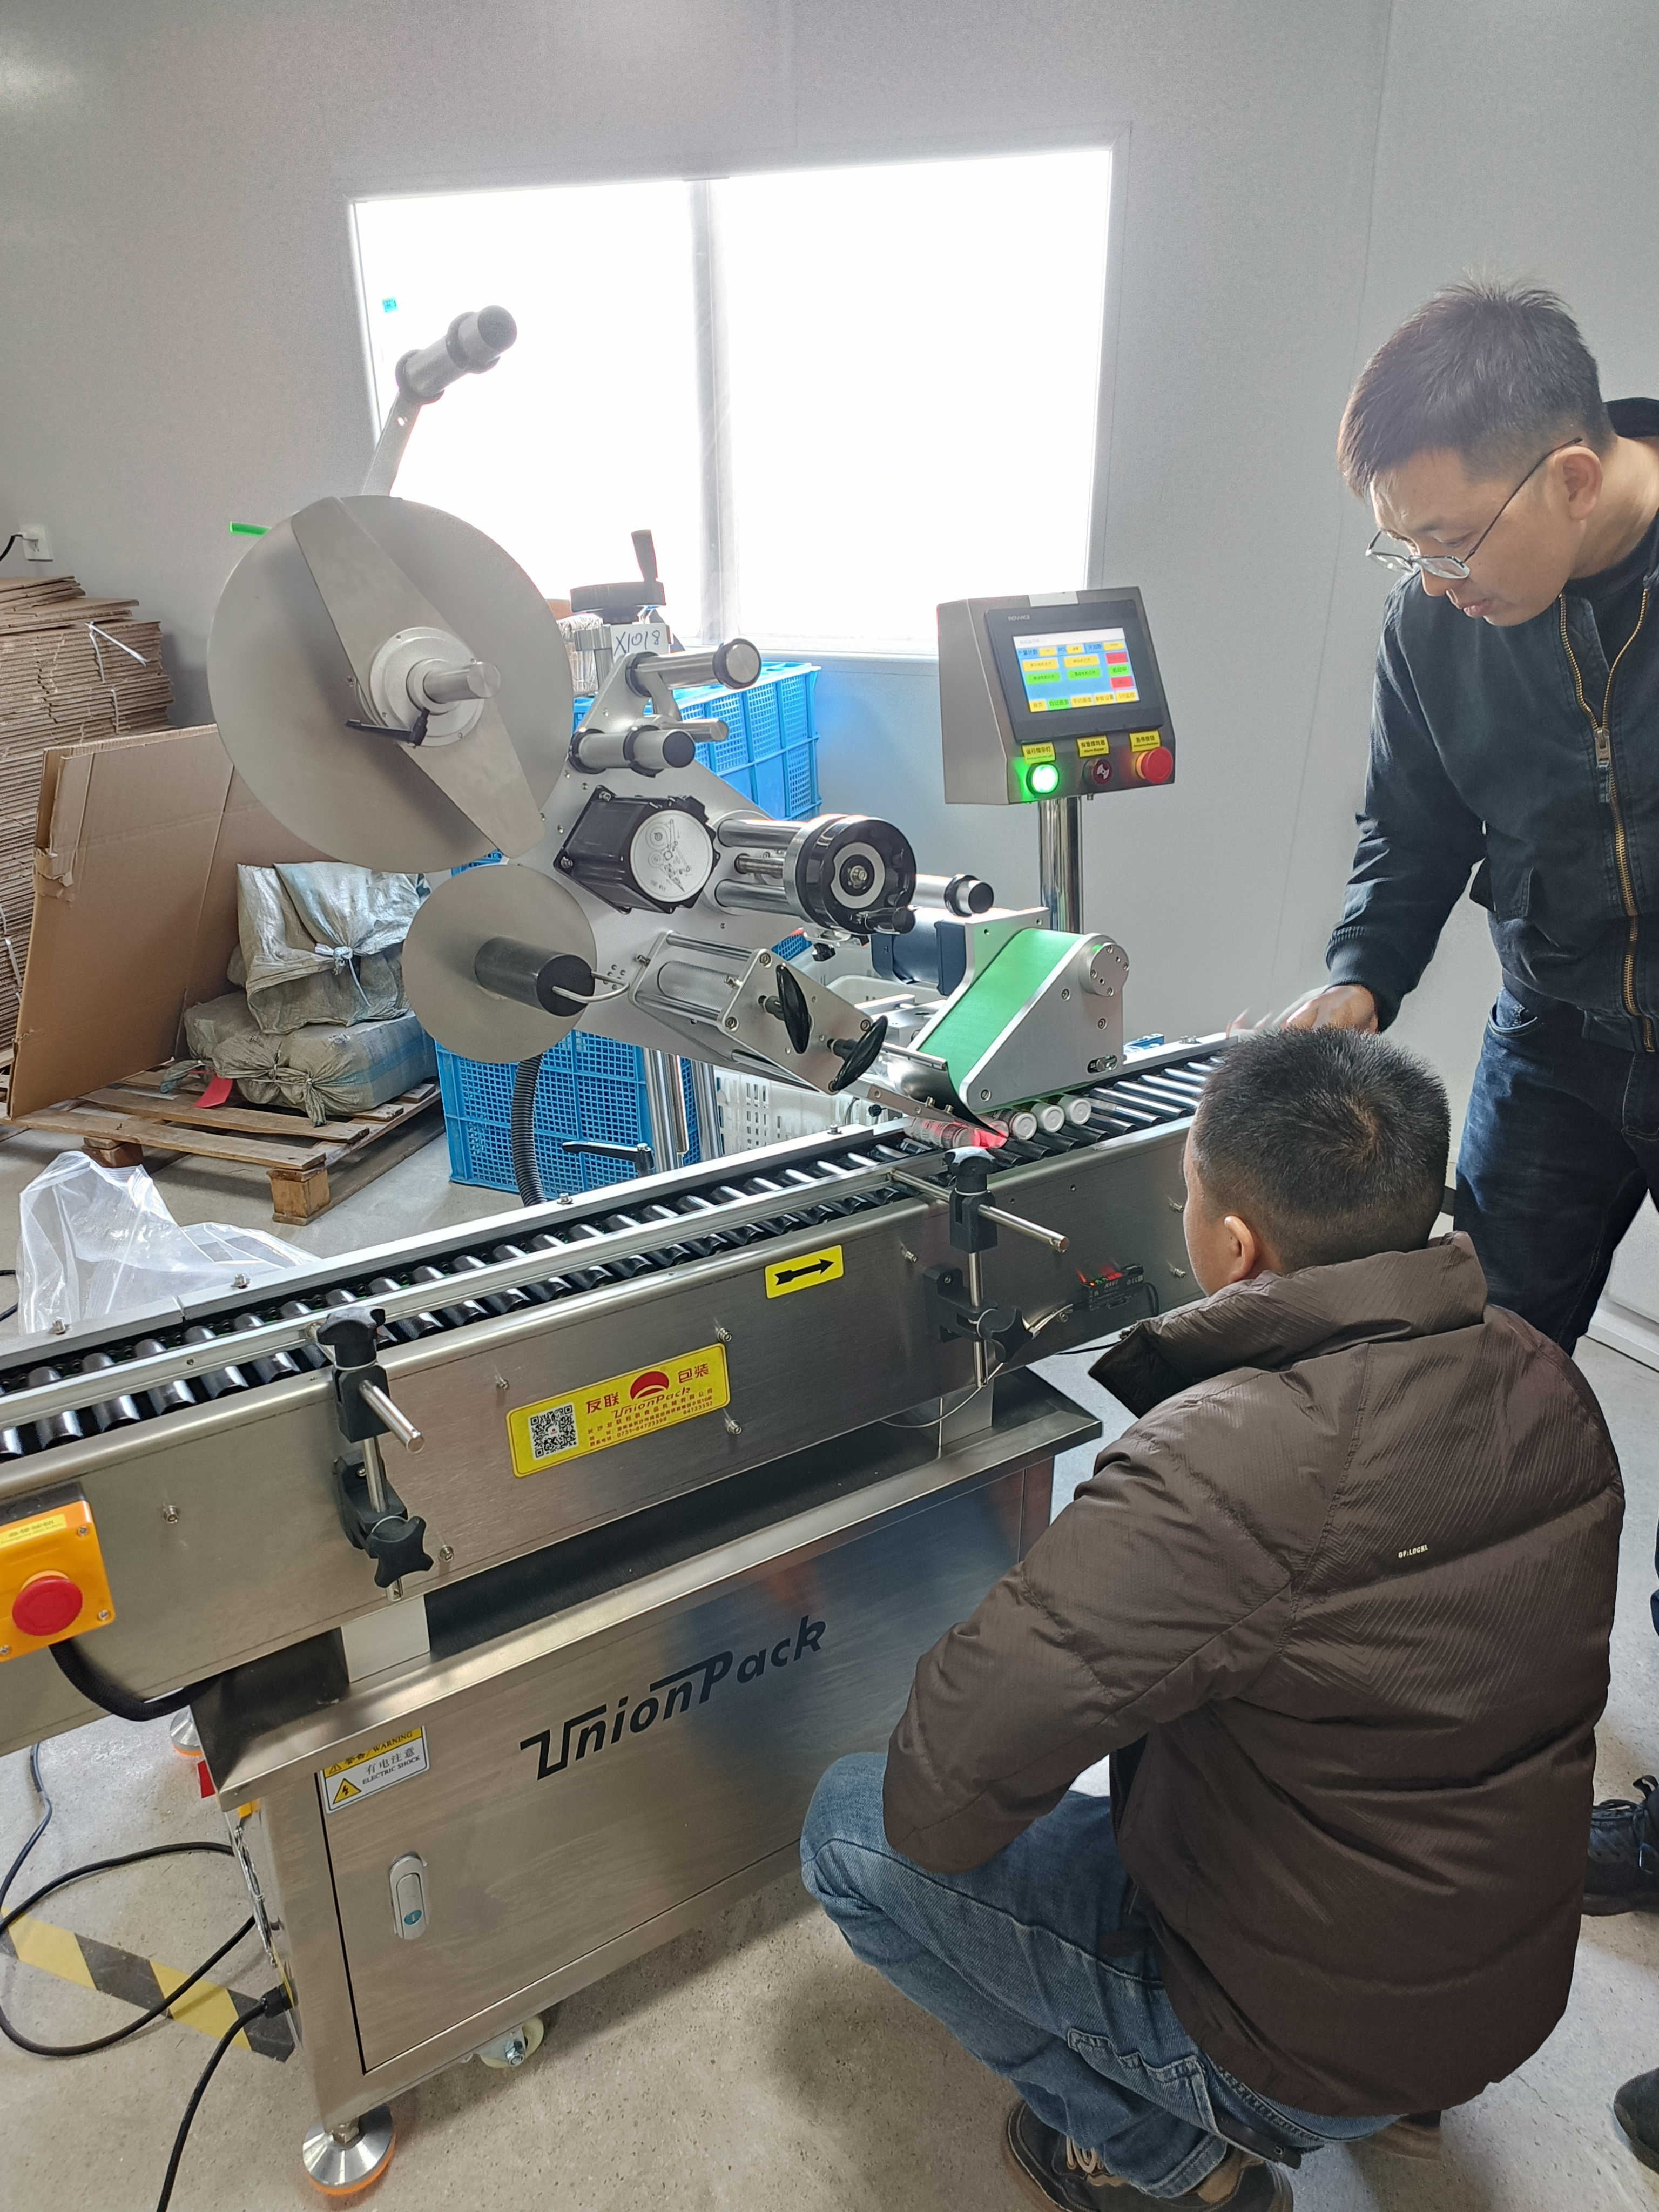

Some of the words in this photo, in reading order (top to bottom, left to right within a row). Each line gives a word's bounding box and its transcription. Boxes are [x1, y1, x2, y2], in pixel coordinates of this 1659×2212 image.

[678, 1363, 709, 1384] 包装
[611, 1387, 691, 1419] UnionPack
[520, 1615, 827, 1781] UnionPack
[362, 1765, 395, 1785] ELECTRIC
[397, 1755, 421, 1770] SHOCK
[366, 1746, 415, 1775] 有电注意
